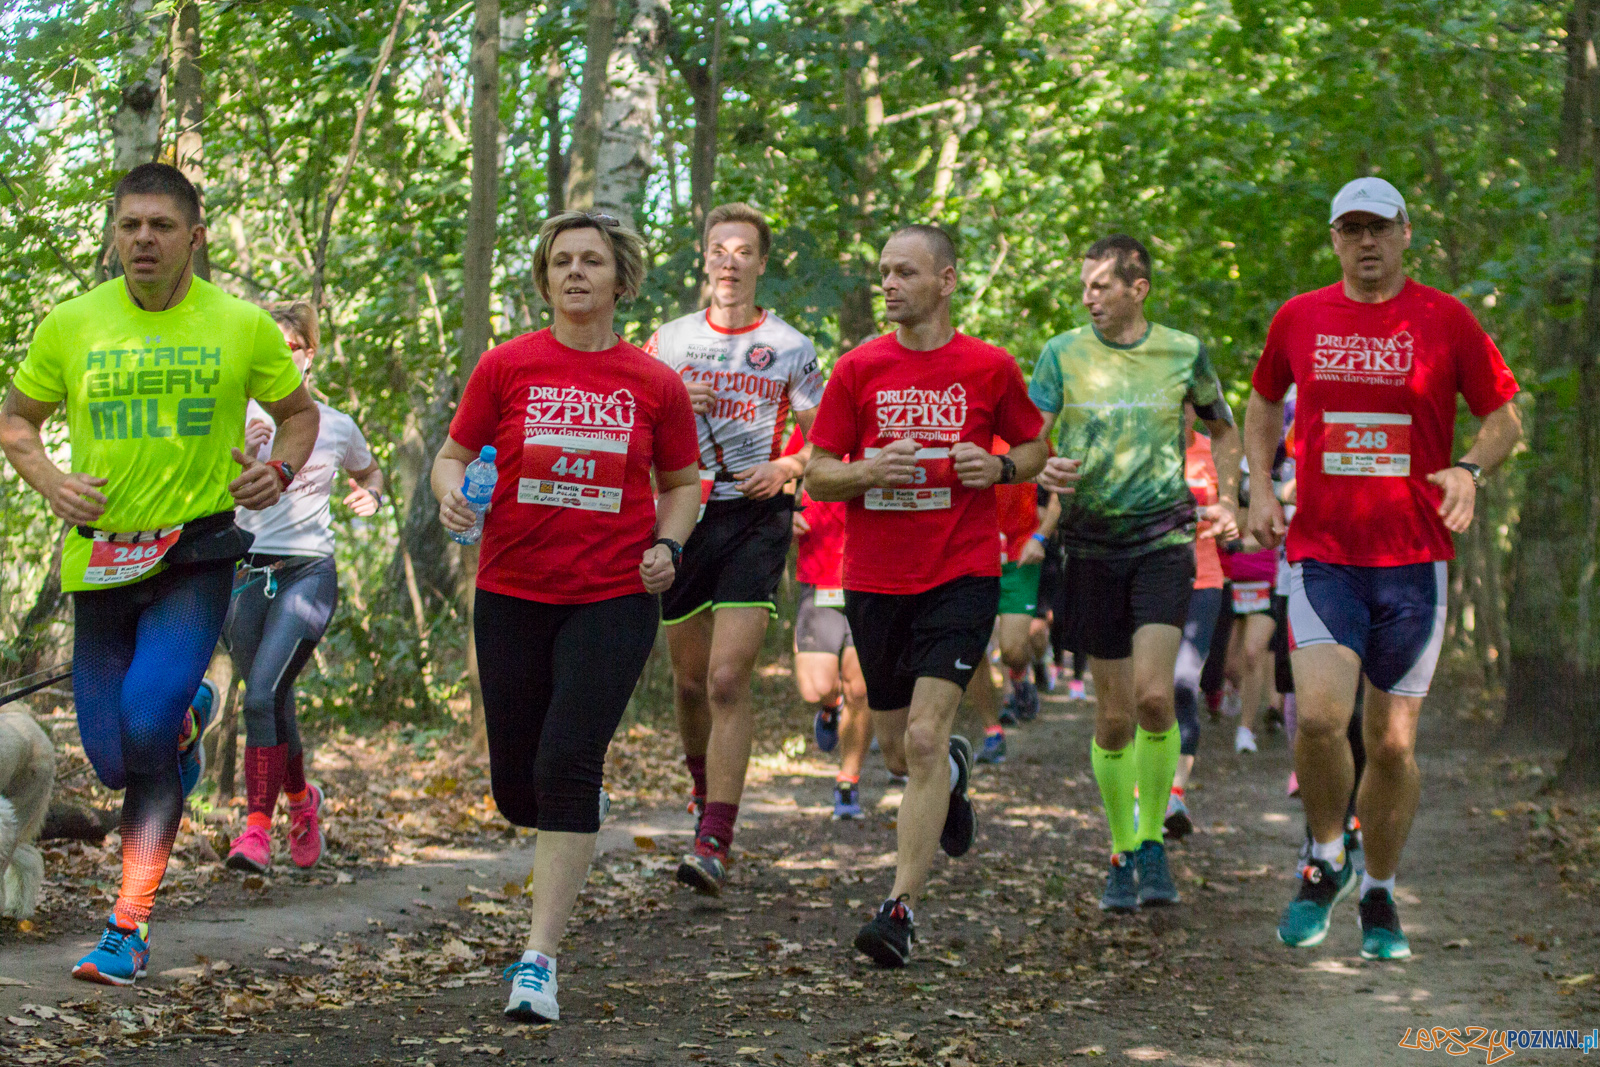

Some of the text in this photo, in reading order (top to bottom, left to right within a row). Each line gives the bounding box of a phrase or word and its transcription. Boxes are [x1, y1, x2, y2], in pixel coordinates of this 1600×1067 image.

[1315, 333, 1397, 351] DRUŻYNA
[87, 346, 221, 370] ATTACK
[1314, 348, 1414, 372] SZPIKU
[87, 369, 221, 398] EVERY
[527, 385, 614, 404] DRUŻYNA
[876, 385, 954, 405] DRUŻYNA
[88, 398, 217, 440] MILE
[525, 402, 636, 428] SZPIKU
[876, 404, 968, 428] SZPIKU
[877, 430, 961, 443] www.darszpiku.pl
[1345, 431, 1388, 450] 248
[551, 455, 596, 480] 441
[557, 484, 580, 493] Karlik
[113, 544, 158, 563] 246
